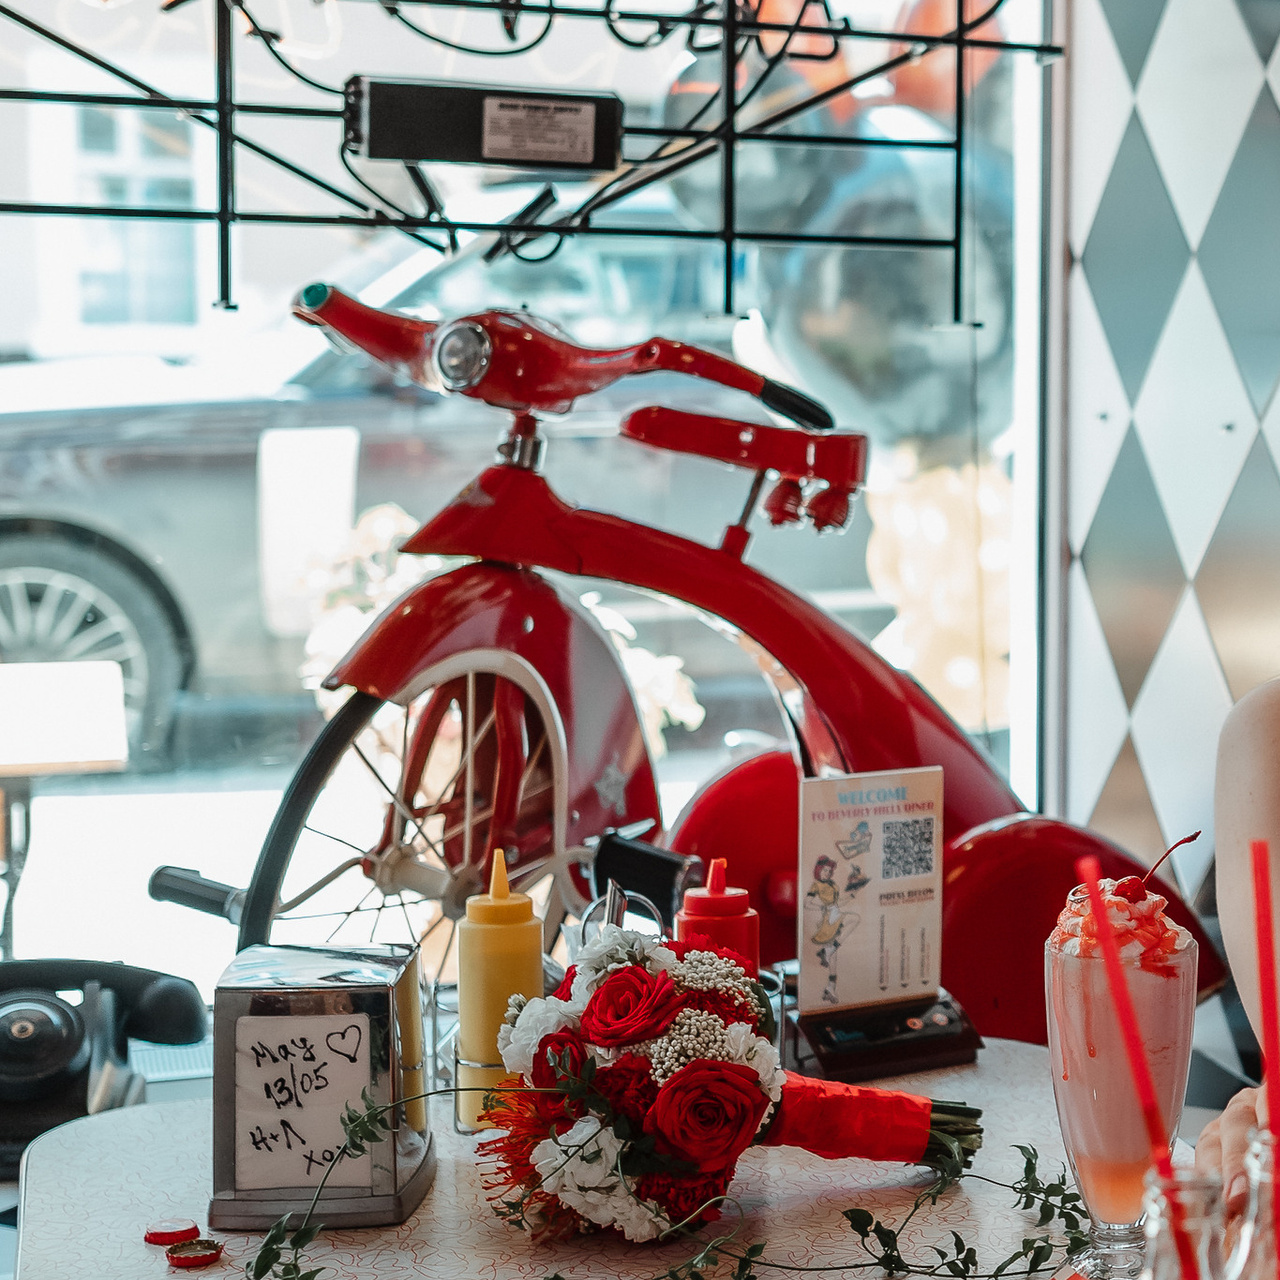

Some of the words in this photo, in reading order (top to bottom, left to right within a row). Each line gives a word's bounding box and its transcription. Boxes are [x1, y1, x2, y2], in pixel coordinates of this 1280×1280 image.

[837, 786, 908, 805] WELCOME
[811, 810, 826, 823] TO
[828, 806, 870, 821] BEVERLY
[904, 800, 934, 814] DINER
[251, 1037, 316, 1067] May
[264, 1062, 329, 1109] 13/05
